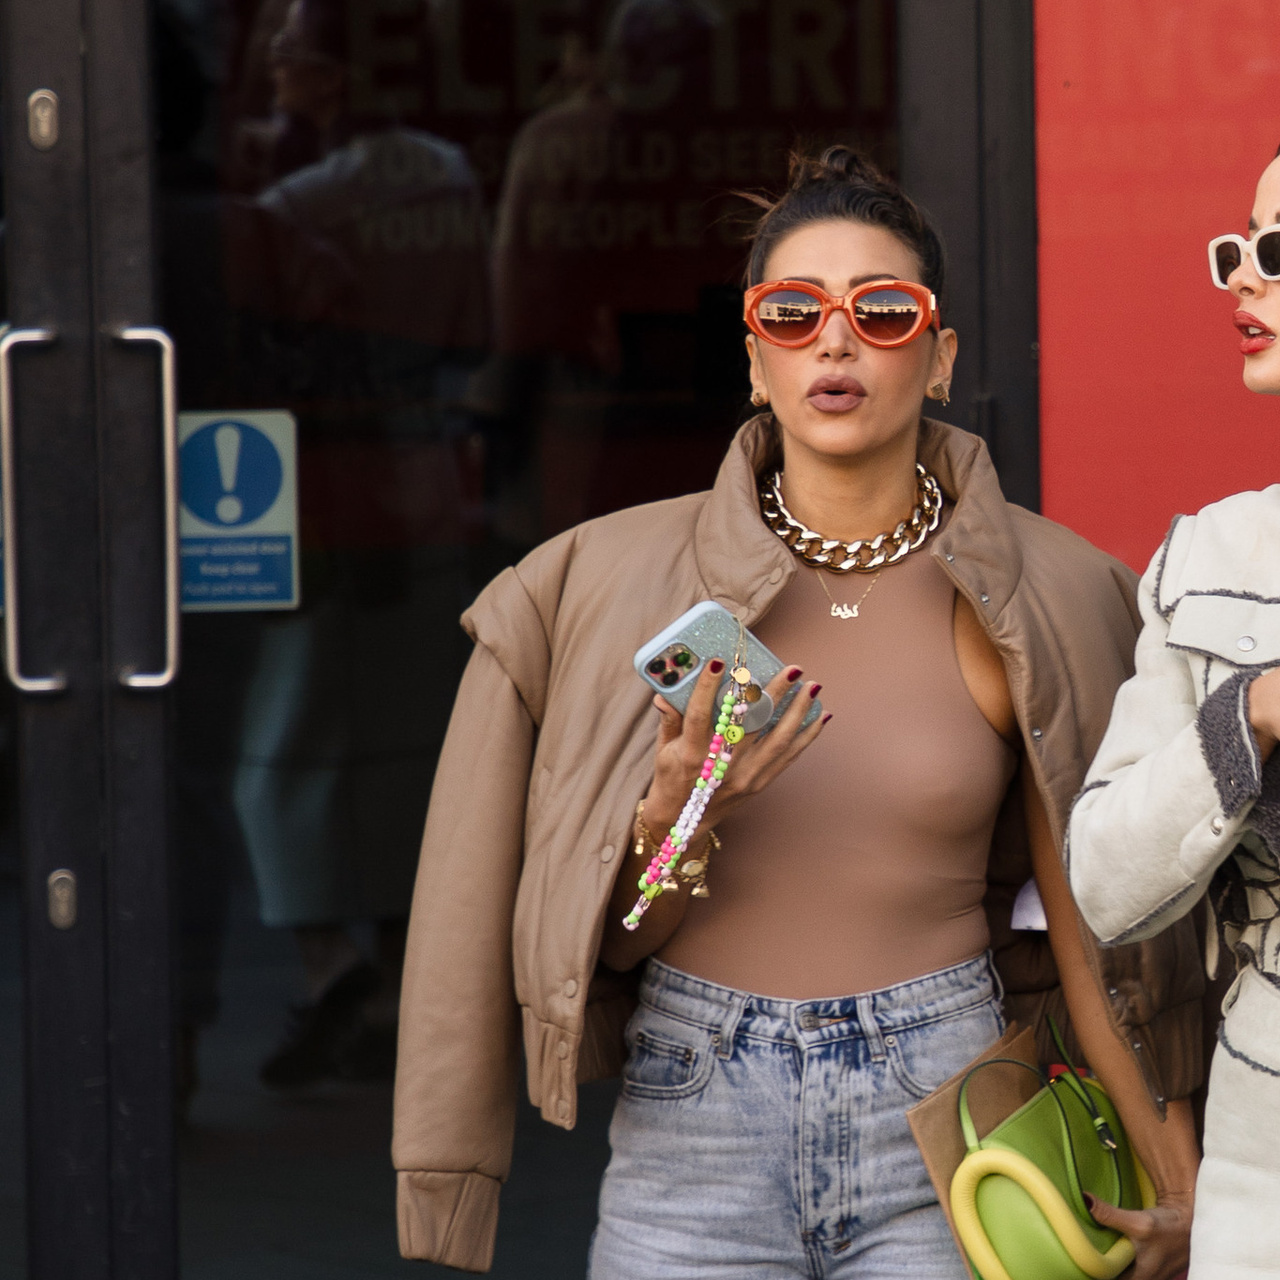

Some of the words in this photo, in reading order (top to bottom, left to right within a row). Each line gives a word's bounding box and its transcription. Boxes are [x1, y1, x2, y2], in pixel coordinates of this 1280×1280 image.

[471, 128, 678, 184] SOULD
[687, 127, 785, 182] SEE
[528, 199, 705, 251] PEOPLE
